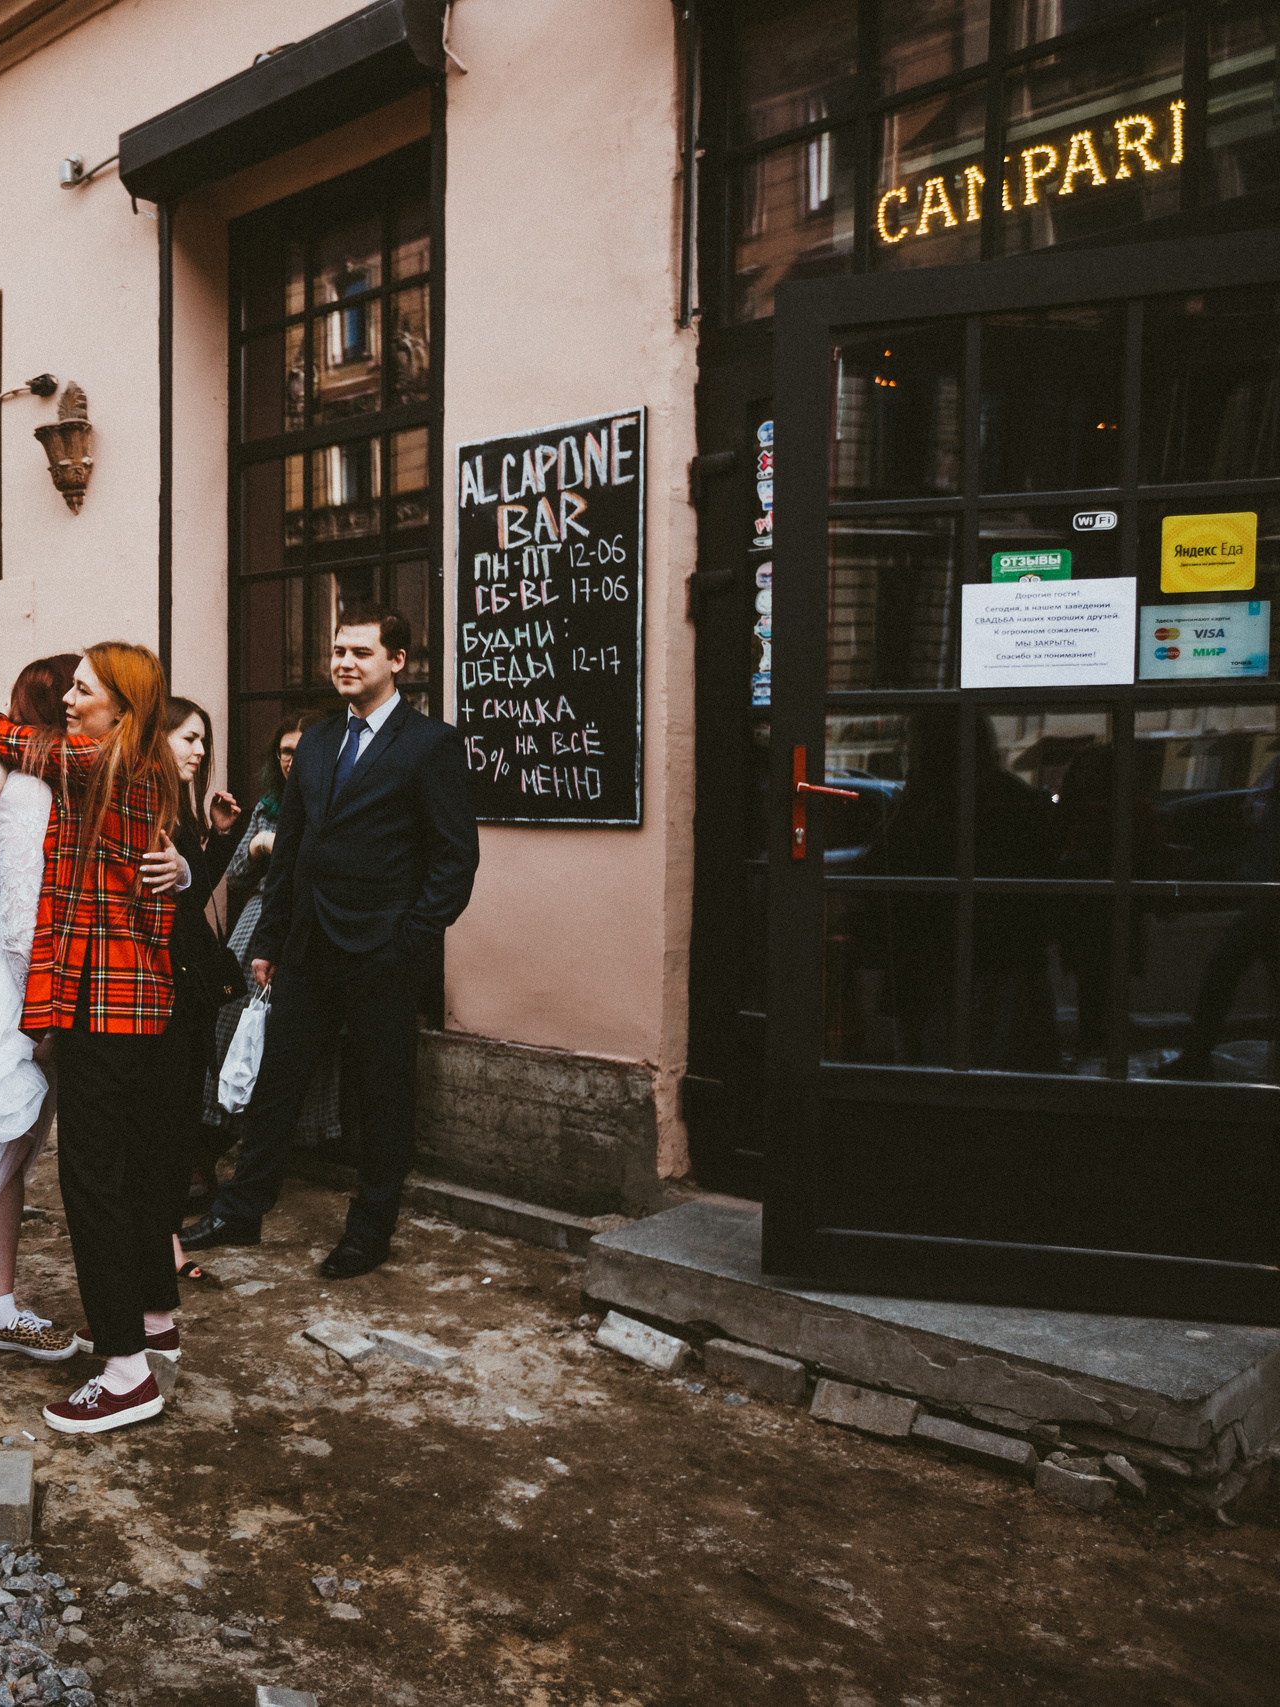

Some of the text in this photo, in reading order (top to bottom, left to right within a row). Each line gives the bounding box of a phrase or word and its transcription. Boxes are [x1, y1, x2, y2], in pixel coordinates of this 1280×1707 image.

[877, 99, 1187, 244] CAMPARI
[500, 416, 638, 503] CAPONE
[497, 491, 590, 549] BAR
[474, 534, 626, 581] ПН-ПТ 12-06
[1174, 542, 1244, 558] Яндекс Еда
[1000, 555, 1061, 567] ОТЗЫВЫ
[475, 575, 629, 616] СБ-ВС 17-06
[1015, 590, 1080, 600] Дорогие гости!
[985, 605, 1022, 613] Сегодня,
[1064, 602, 1111, 611] заведении
[975, 617, 1015, 625] СВАДЬБА
[1047, 615, 1085, 623] хороших
[1086, 613, 1120, 622] друзей.
[1047, 626, 1100, 635] сожалению,
[1193, 628, 1225, 639] VISA
[1033, 639, 1077, 647] ЗАКРЫТЫ.
[996, 652, 1031, 660] Спасибо
[1044, 651, 1096, 659] понимание!
[1192, 647, 1226, 657] МИР
[462, 646, 621, 690] ОБЕДЫ 12-17
[482, 695, 576, 729] СКИДКА
[515, 735, 539, 755] НА
[551, 721, 605, 756] ВСЁ
[521, 764, 601, 800] МЕНЮ
